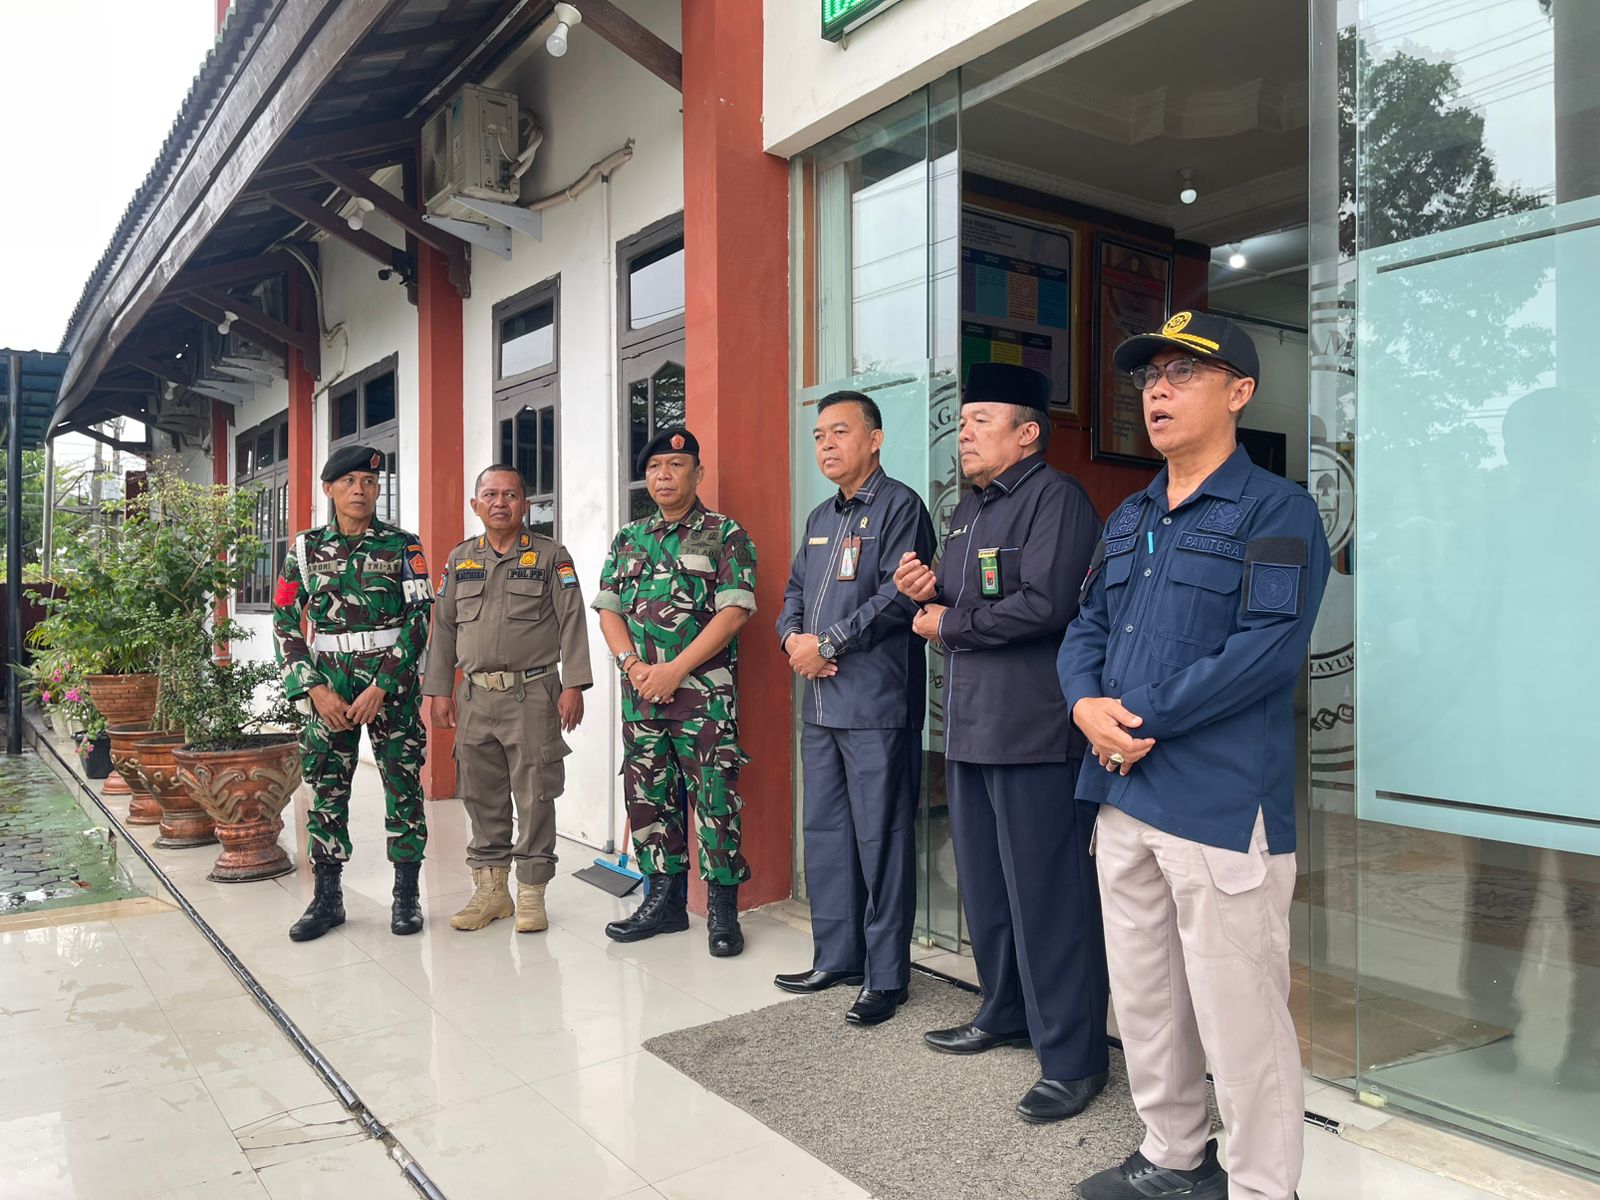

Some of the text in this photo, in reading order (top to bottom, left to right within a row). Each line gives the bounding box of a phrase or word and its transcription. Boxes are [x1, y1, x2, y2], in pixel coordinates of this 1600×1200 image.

[1185, 536, 1241, 556] PANITERA
[509, 569, 543, 579] POL PP
